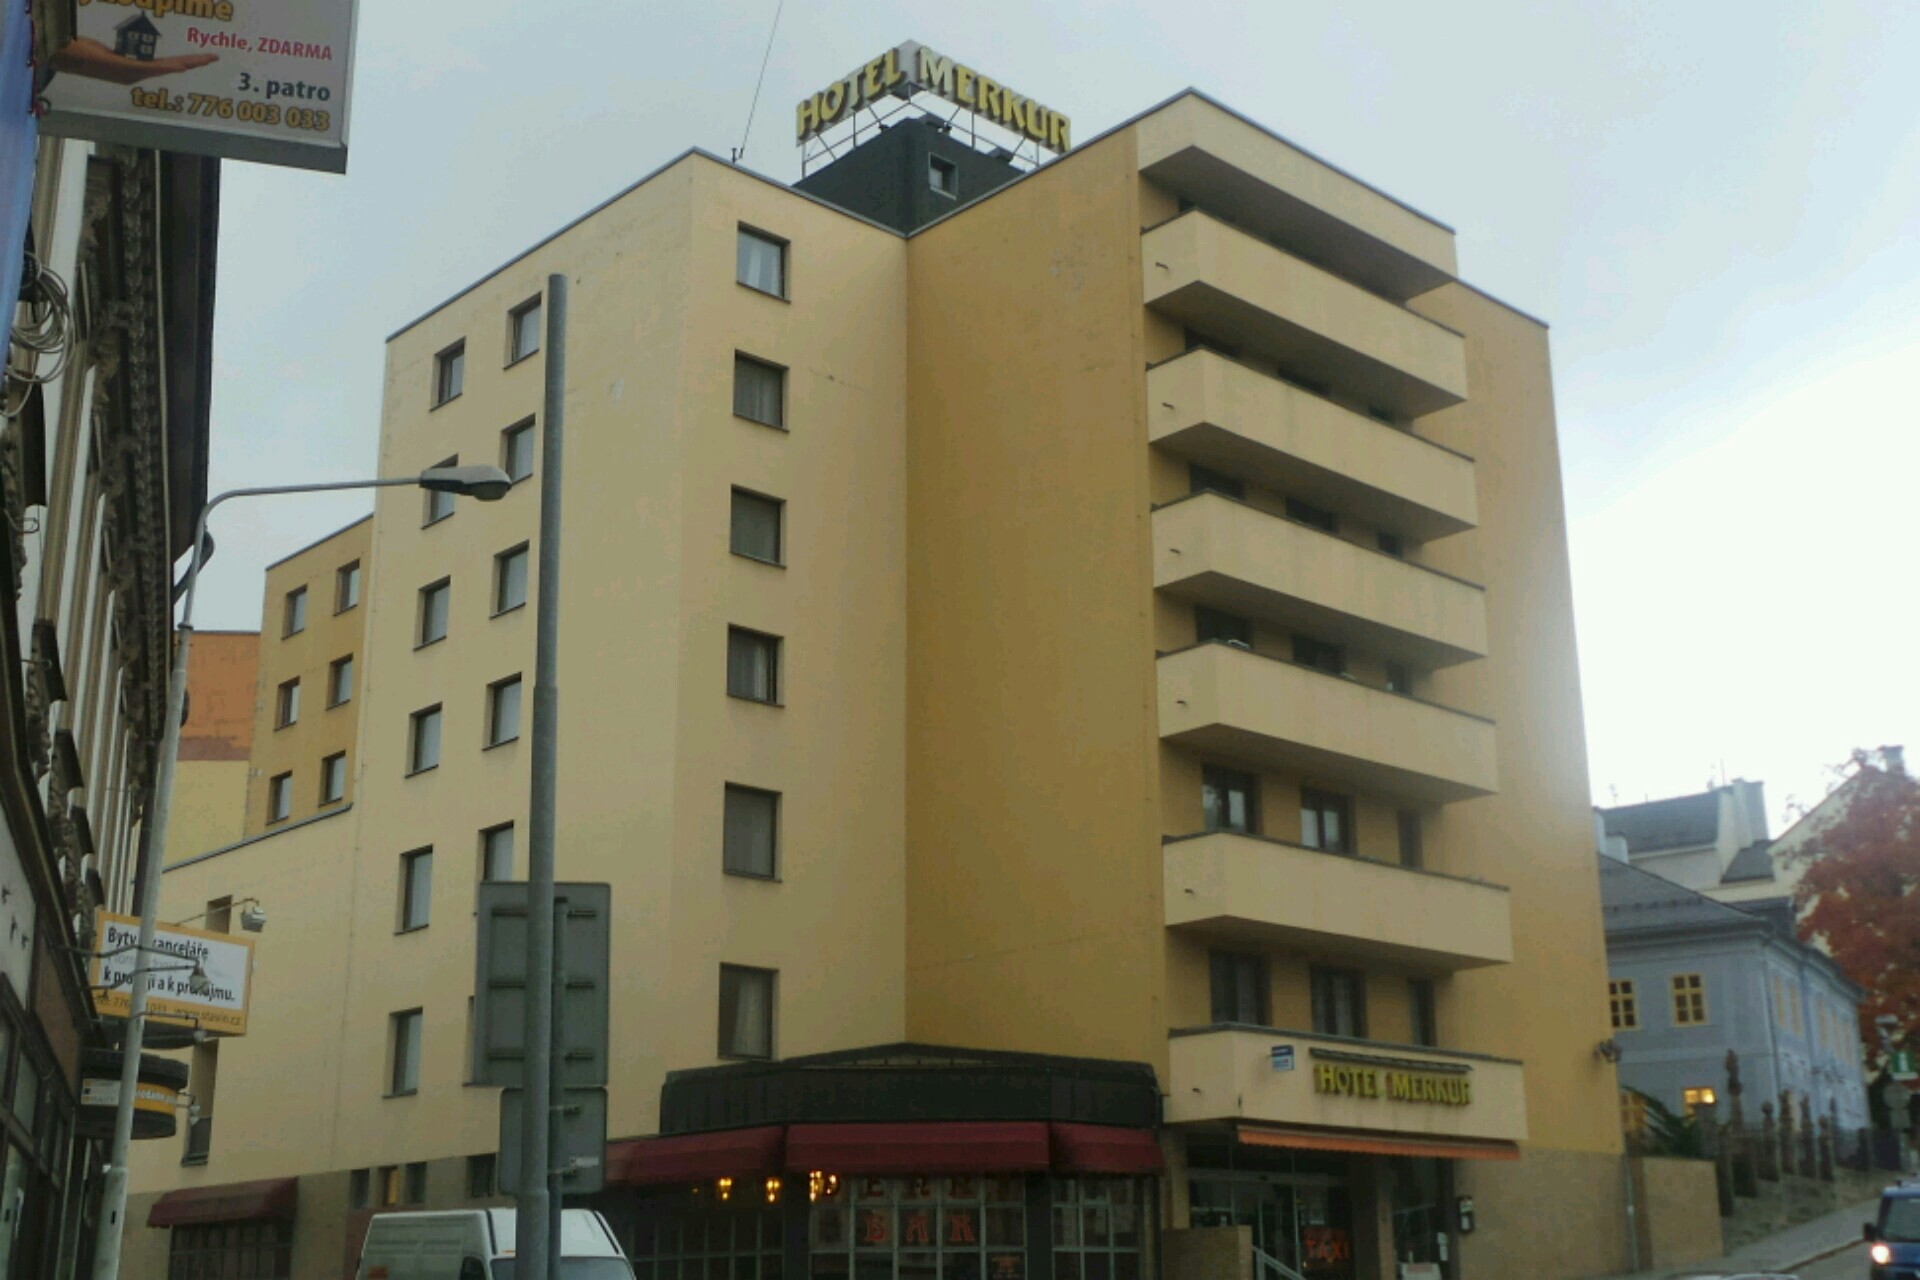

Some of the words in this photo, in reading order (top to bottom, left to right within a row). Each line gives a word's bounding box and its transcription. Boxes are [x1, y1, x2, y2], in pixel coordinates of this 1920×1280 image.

[186, 26, 252, 53] Rychle,
[257, 36, 332, 61] ZDARMA
[237, 72, 260, 93] 3.
[265, 77, 331, 102] patro
[796, 47, 905, 141] HOTEL
[918, 46, 1070, 152] MERKUR
[130, 86, 183, 113] tel.:
[187, 92, 234, 119] 776
[236, 100, 281, 125] 003
[284, 108, 331, 132] 033
[103, 966, 112, 981] k
[157, 979, 165, 989] a
[167, 976, 175, 991] k
[1316, 1063, 1385, 1100] HOTEL
[1387, 1072, 1472, 1105] MERKUR
